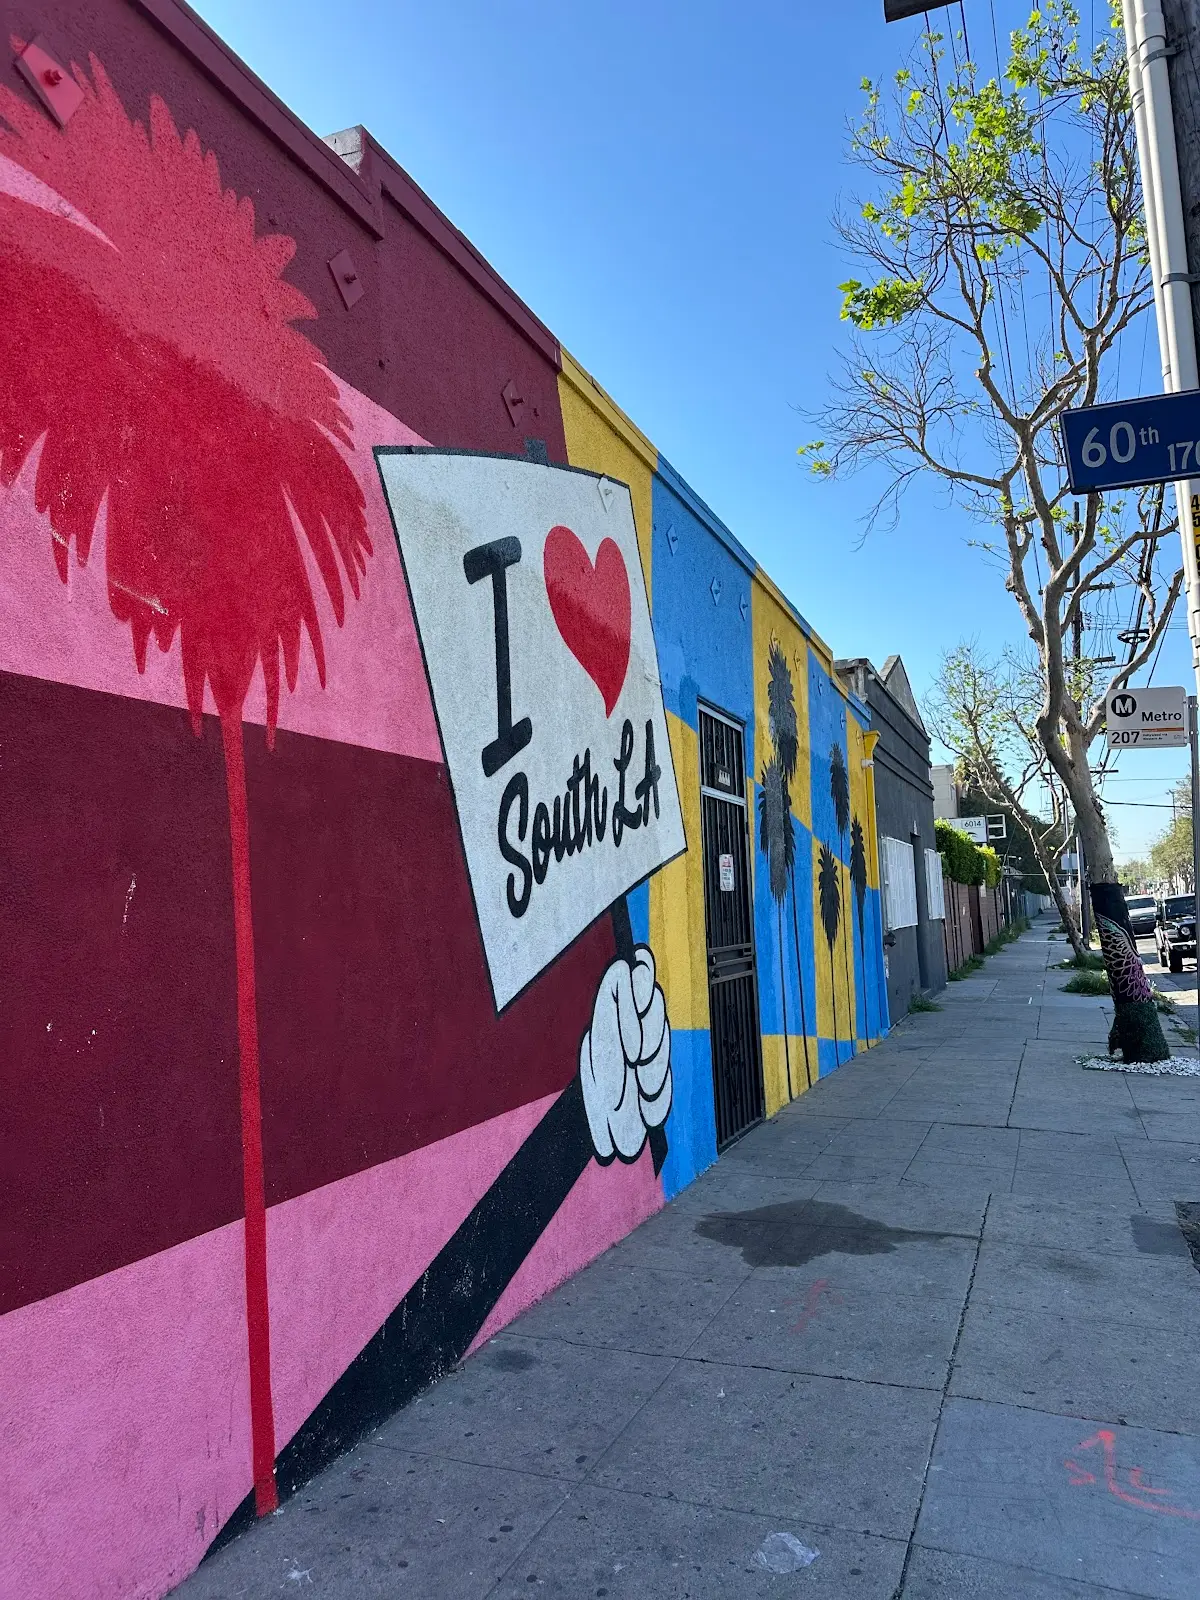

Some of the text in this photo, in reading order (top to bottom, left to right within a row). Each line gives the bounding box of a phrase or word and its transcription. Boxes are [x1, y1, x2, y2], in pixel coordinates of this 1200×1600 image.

[1081, 421, 1160, 468] 60th
[463, 535, 533, 778] I
[1111, 731, 1140, 744] 207
[1141, 711, 1182, 722] Metro
[498, 718, 662, 919] South LA
